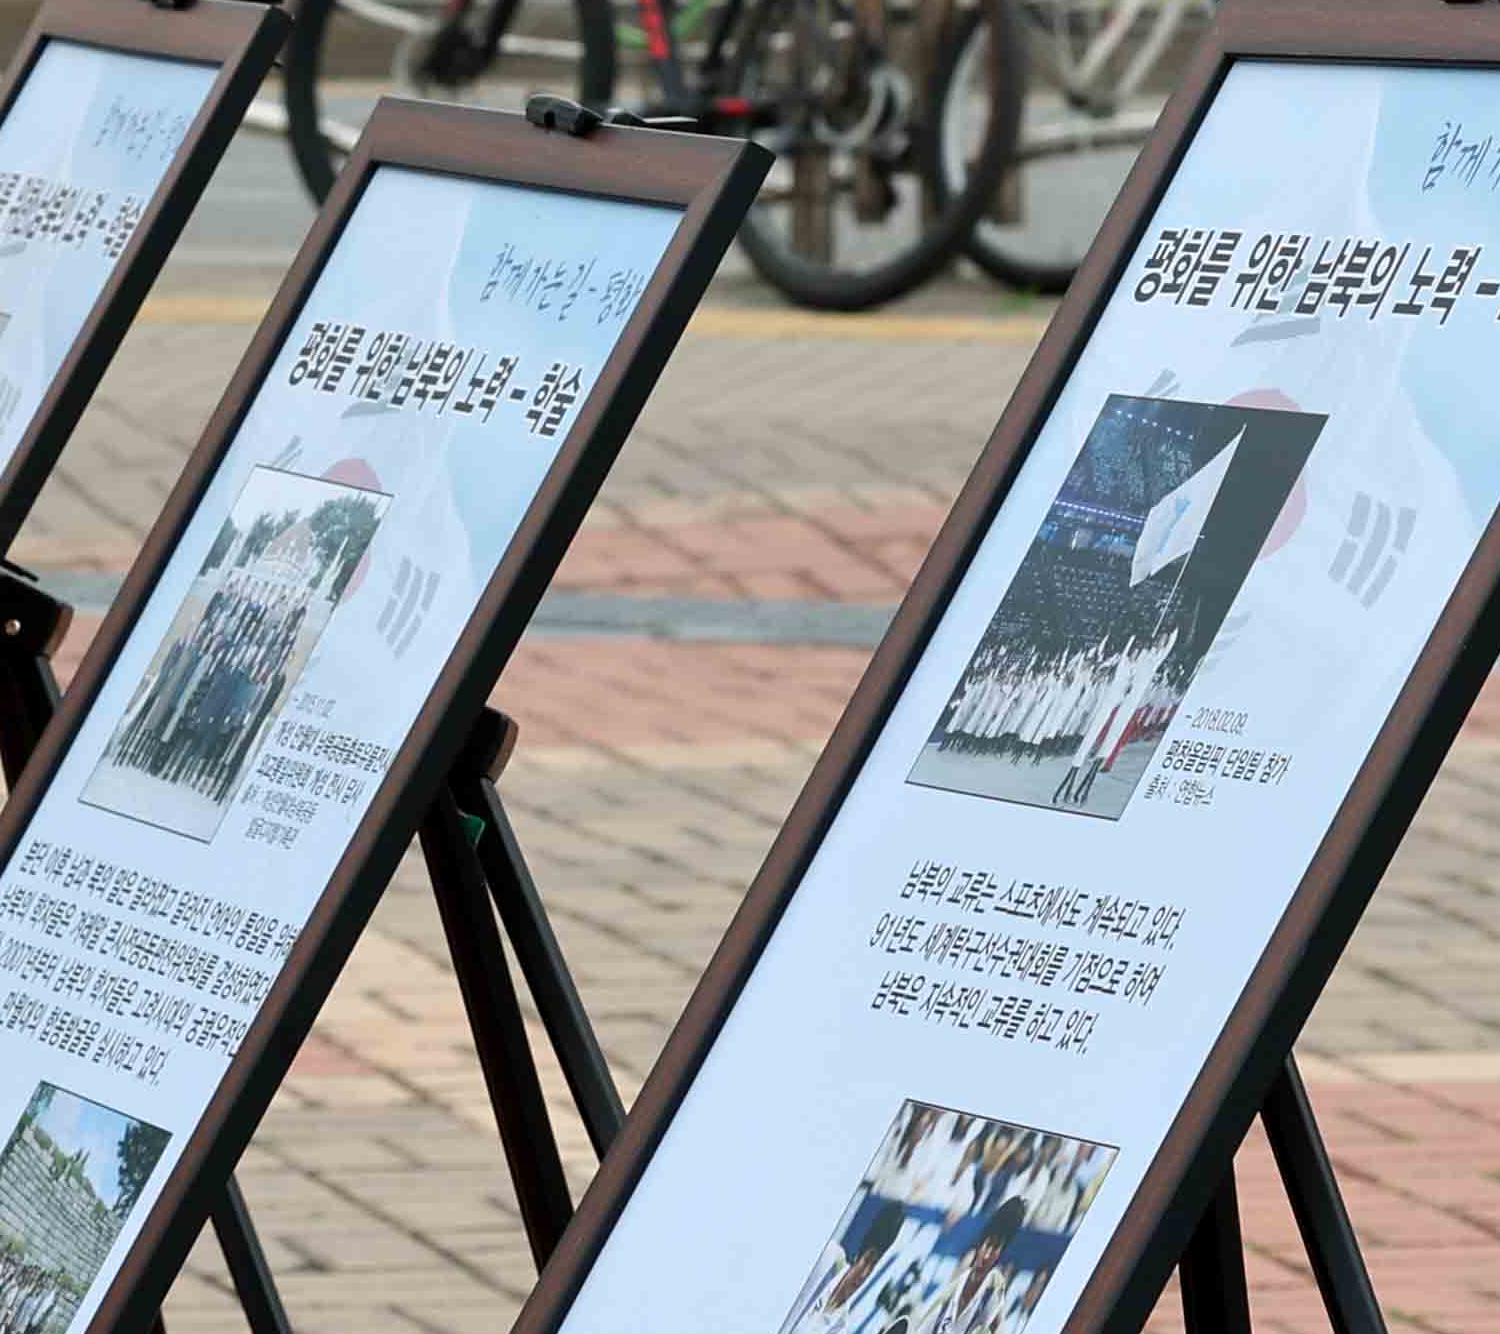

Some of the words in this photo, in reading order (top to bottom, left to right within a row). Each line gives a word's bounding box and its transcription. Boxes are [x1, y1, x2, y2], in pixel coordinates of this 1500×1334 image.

[1422, 122, 1497, 193] 함께
[480, 243, 534, 302] 함께
[522, 259, 568, 314] 가는
[554, 258, 597, 322] 길
[1134, 228, 1243, 306] 평화를
[1230, 234, 1311, 313] 위한
[1289, 239, 1411, 320] 남북의
[1392, 247, 1482, 325] 노력
[289, 323, 366, 392] 평화를
[350, 332, 410, 403] 위한
[386, 342, 474, 415] 남북의
[453, 354, 519, 423] 노력
[526, 363, 582, 437] 학술
[1162, 740, 1227, 776] 평창올림픽
[1221, 749, 1266, 781] 단일팀
[1259, 753, 1292, 785] 참가
[19, 840, 52, 875] 분단
[44, 847, 72, 883] 이후
[62, 854, 94, 891] 남과
[87, 862, 118, 899] 북의
[106, 869, 139, 907] 말은
[169, 891, 214, 933] 달라진
[199, 902, 246, 945] 언어의
[235, 912, 278, 955] 통일을
[900, 861, 957, 905] 남북의
[946, 872, 998, 914] 교류는
[993, 880, 1089, 929] 스포츠에서도
[1082, 895, 1150, 941] 계속되고
[1141, 906, 1186, 950] 있다.
[870, 913, 927, 954] 91년도
[919, 923, 1069, 987] 세계탁구선수권대회를
[1061, 951, 1130, 995] 기점으로
[1124, 963, 1166, 1006] 하여
[38, 1006, 101, 1057] 합동발굴을
[92, 1027, 144, 1071] 실시하고
[136, 1043, 170, 1085] 있다.
[872, 971, 925, 1015] 남북은
[918, 980, 988, 1029] 지속적인
[976, 996, 1032, 1039] 교류를
[1026, 1003, 1064, 1043] 하고
[1056, 1009, 1100, 1054] 있다.
